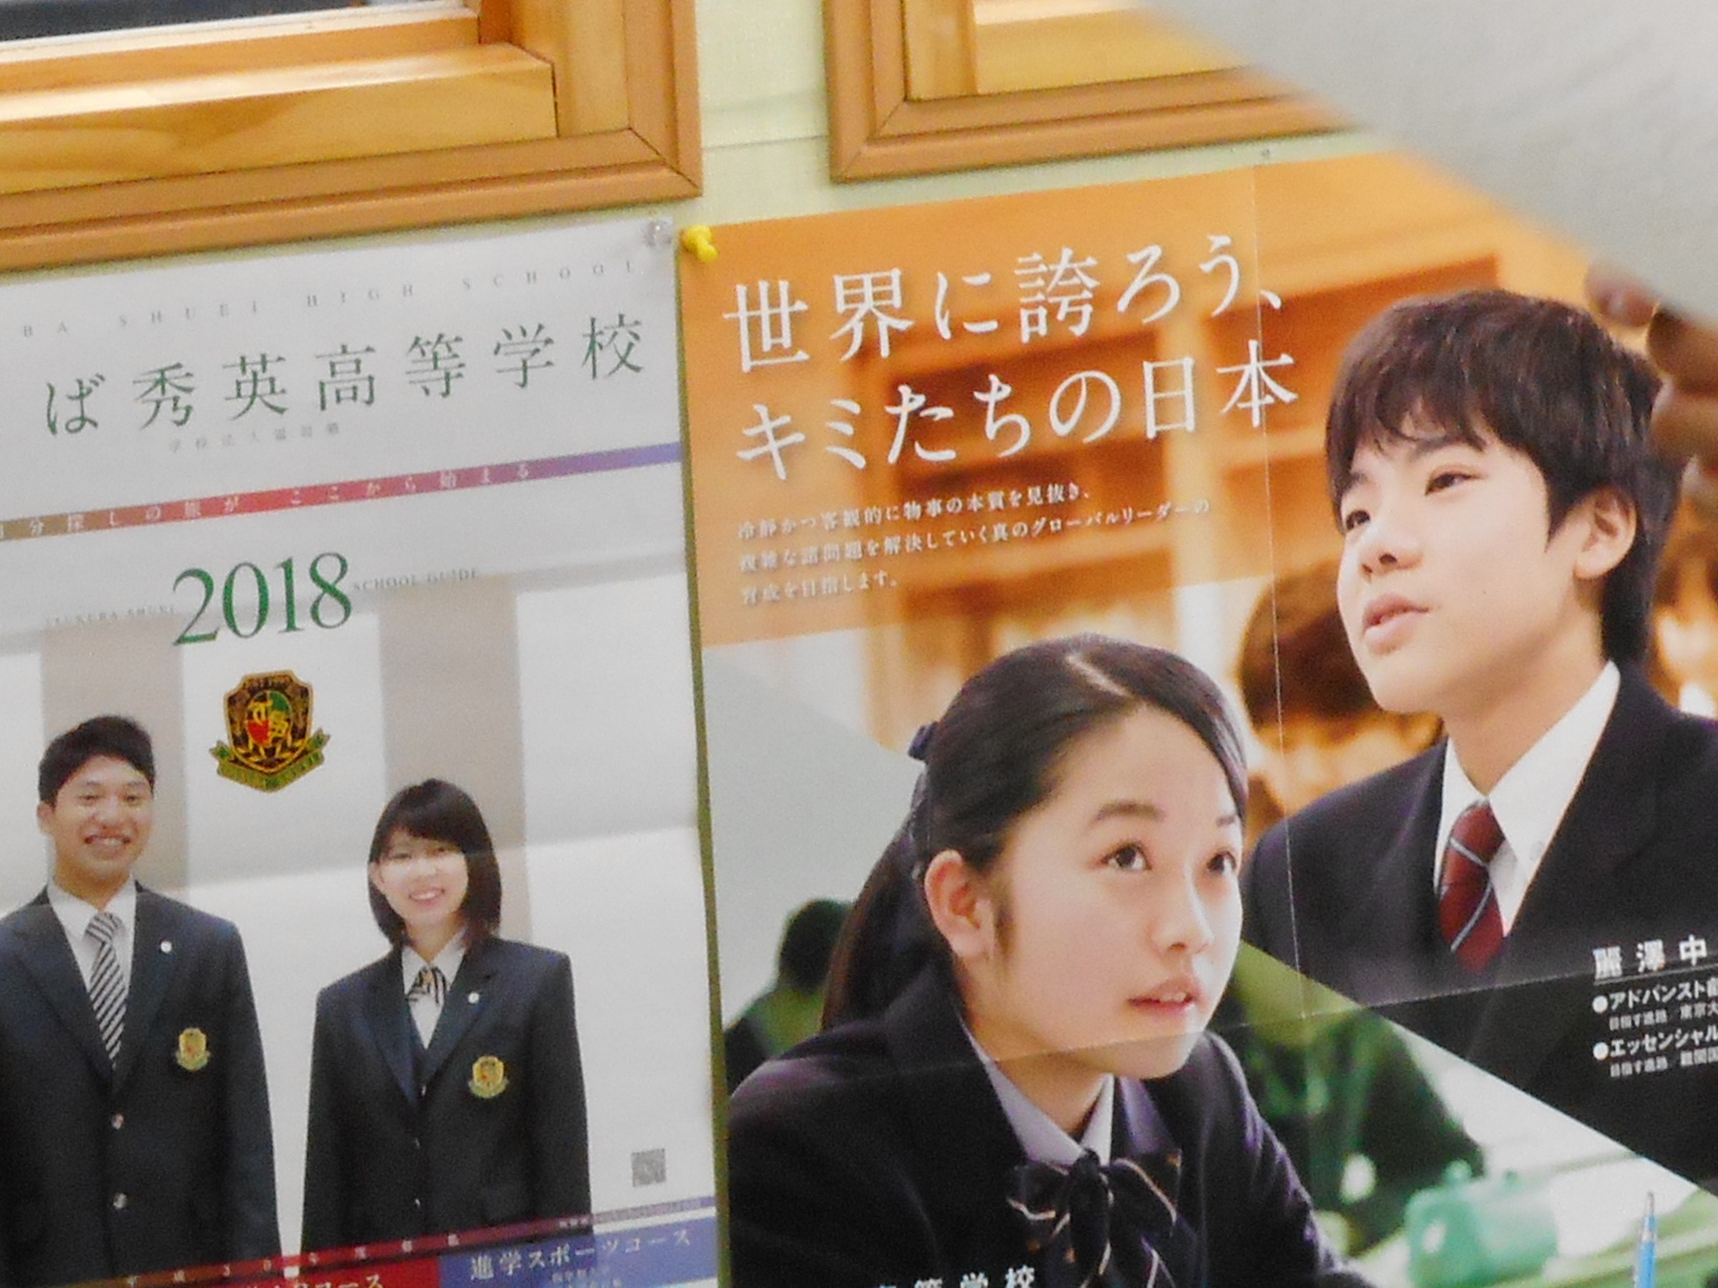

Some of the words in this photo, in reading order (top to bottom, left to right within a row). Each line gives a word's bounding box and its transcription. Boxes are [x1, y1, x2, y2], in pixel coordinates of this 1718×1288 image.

[118, 300, 258, 327] SHUEI
[306, 283, 414, 308] HIGH
[462, 260, 634, 292] SCHOOL
[722, 234, 1283, 373] 世界に誇ろう、
[736, 339, 1300, 481] キミたちの日本
[172, 552, 353, 646] 2018
[469, 1228, 692, 1282] 進学スポーツコース
